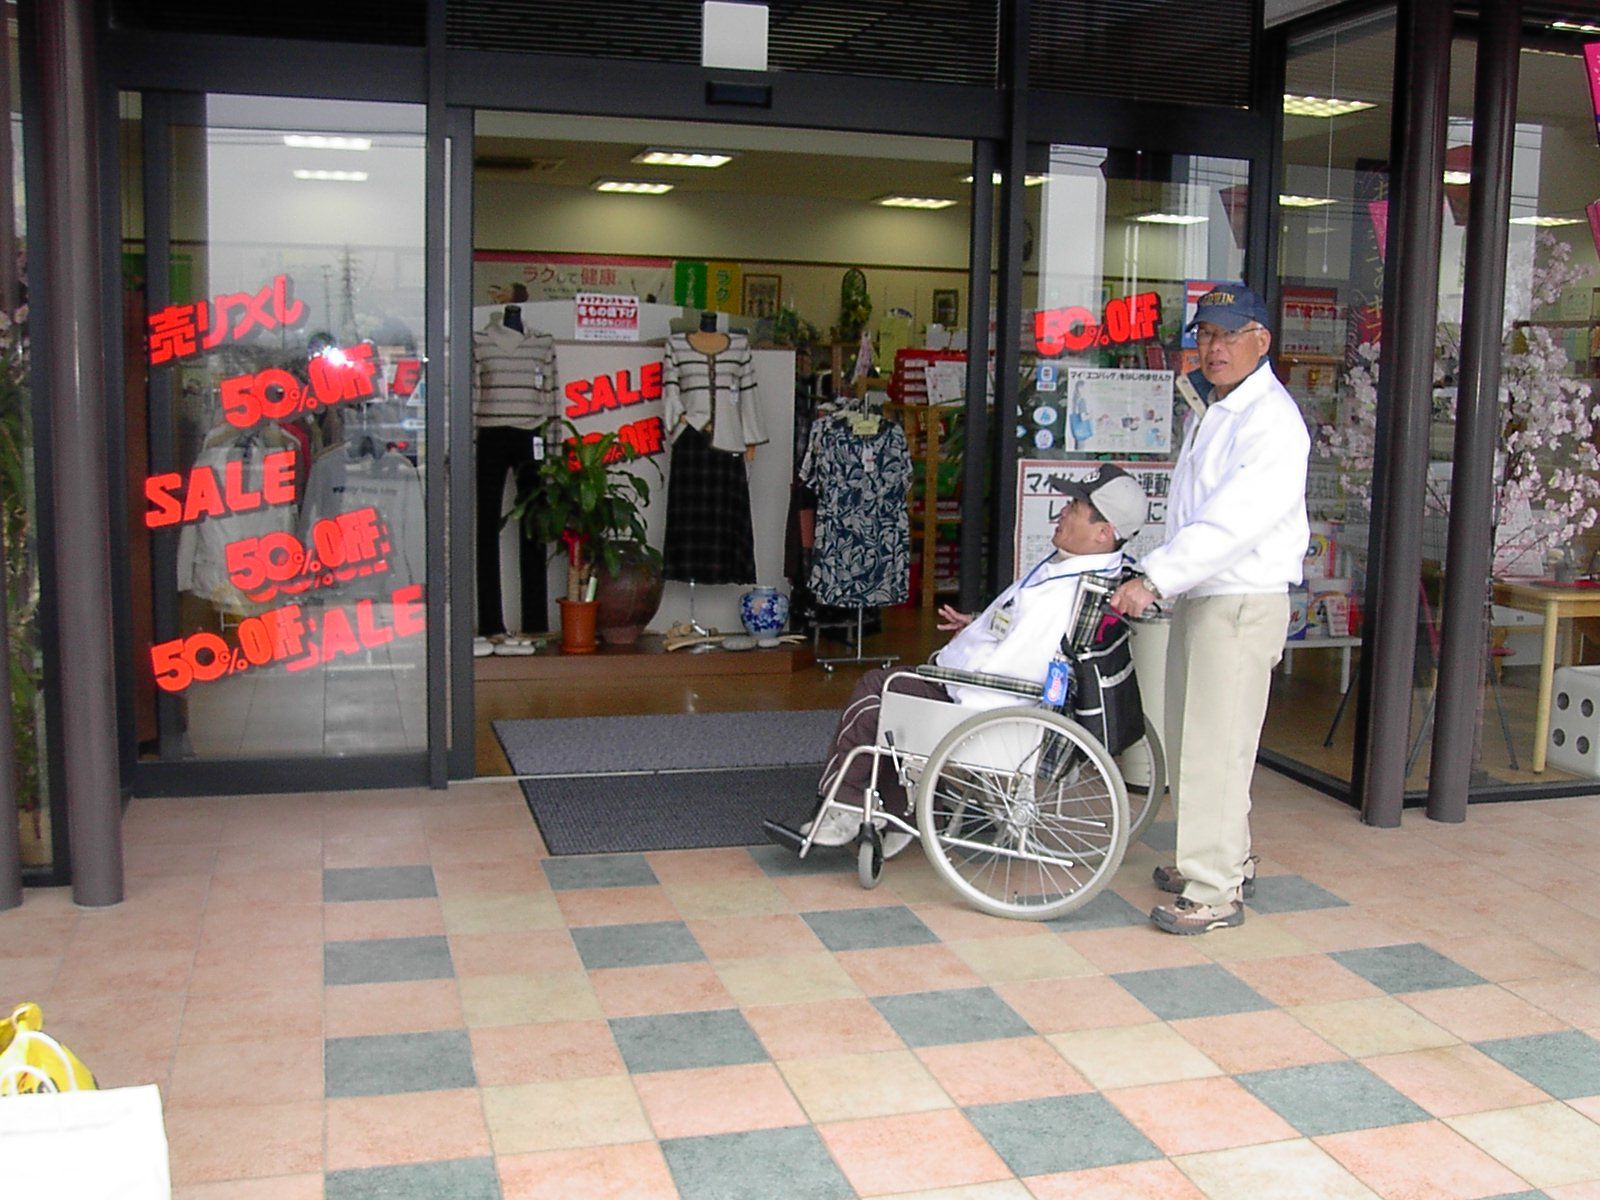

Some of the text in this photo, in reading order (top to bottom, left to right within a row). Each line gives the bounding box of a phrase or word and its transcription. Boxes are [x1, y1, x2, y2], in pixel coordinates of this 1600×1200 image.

[148, 273, 304, 364] 売りつくし
[565, 361, 663, 419] SALE
[145, 450, 297, 528] SALE
[225, 507, 378, 591] 50%OFF
[151, 604, 306, 693] 50%OFF
